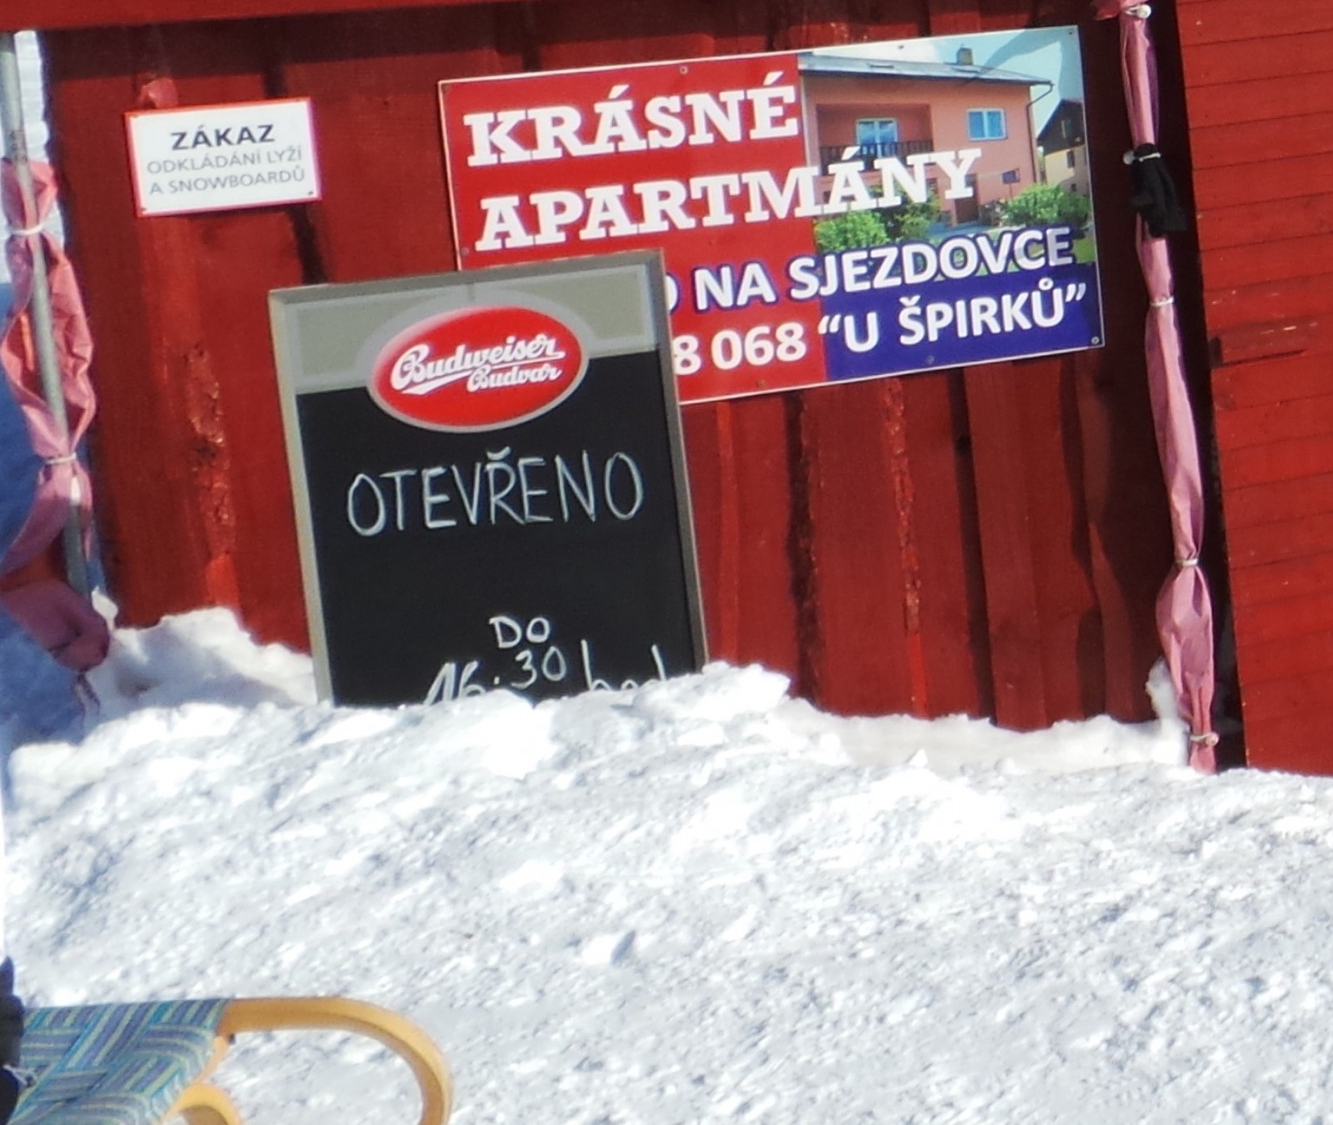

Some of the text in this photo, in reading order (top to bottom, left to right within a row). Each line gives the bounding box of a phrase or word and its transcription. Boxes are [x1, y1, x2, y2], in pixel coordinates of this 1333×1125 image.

[171, 124, 275, 151] ZÁKAZ
[463, 71, 799, 167] KRÁSNÉ
[147, 144, 303, 175] ODKLÁDÁNÍ LYŽÍ
[149, 165, 306, 196] A SNOWBOARDŮ
[474, 146, 982, 252] APARTMÁNY
[694, 261, 776, 313] NA
[789, 224, 1075, 298] SJEZDOVCE
[390, 333, 565, 394] Budweiser
[710, 323, 807, 373] 068
[466, 364, 563, 394] Budvar
[347, 446, 645, 536] OTEVŘENO
[489, 615, 551, 649] DO
